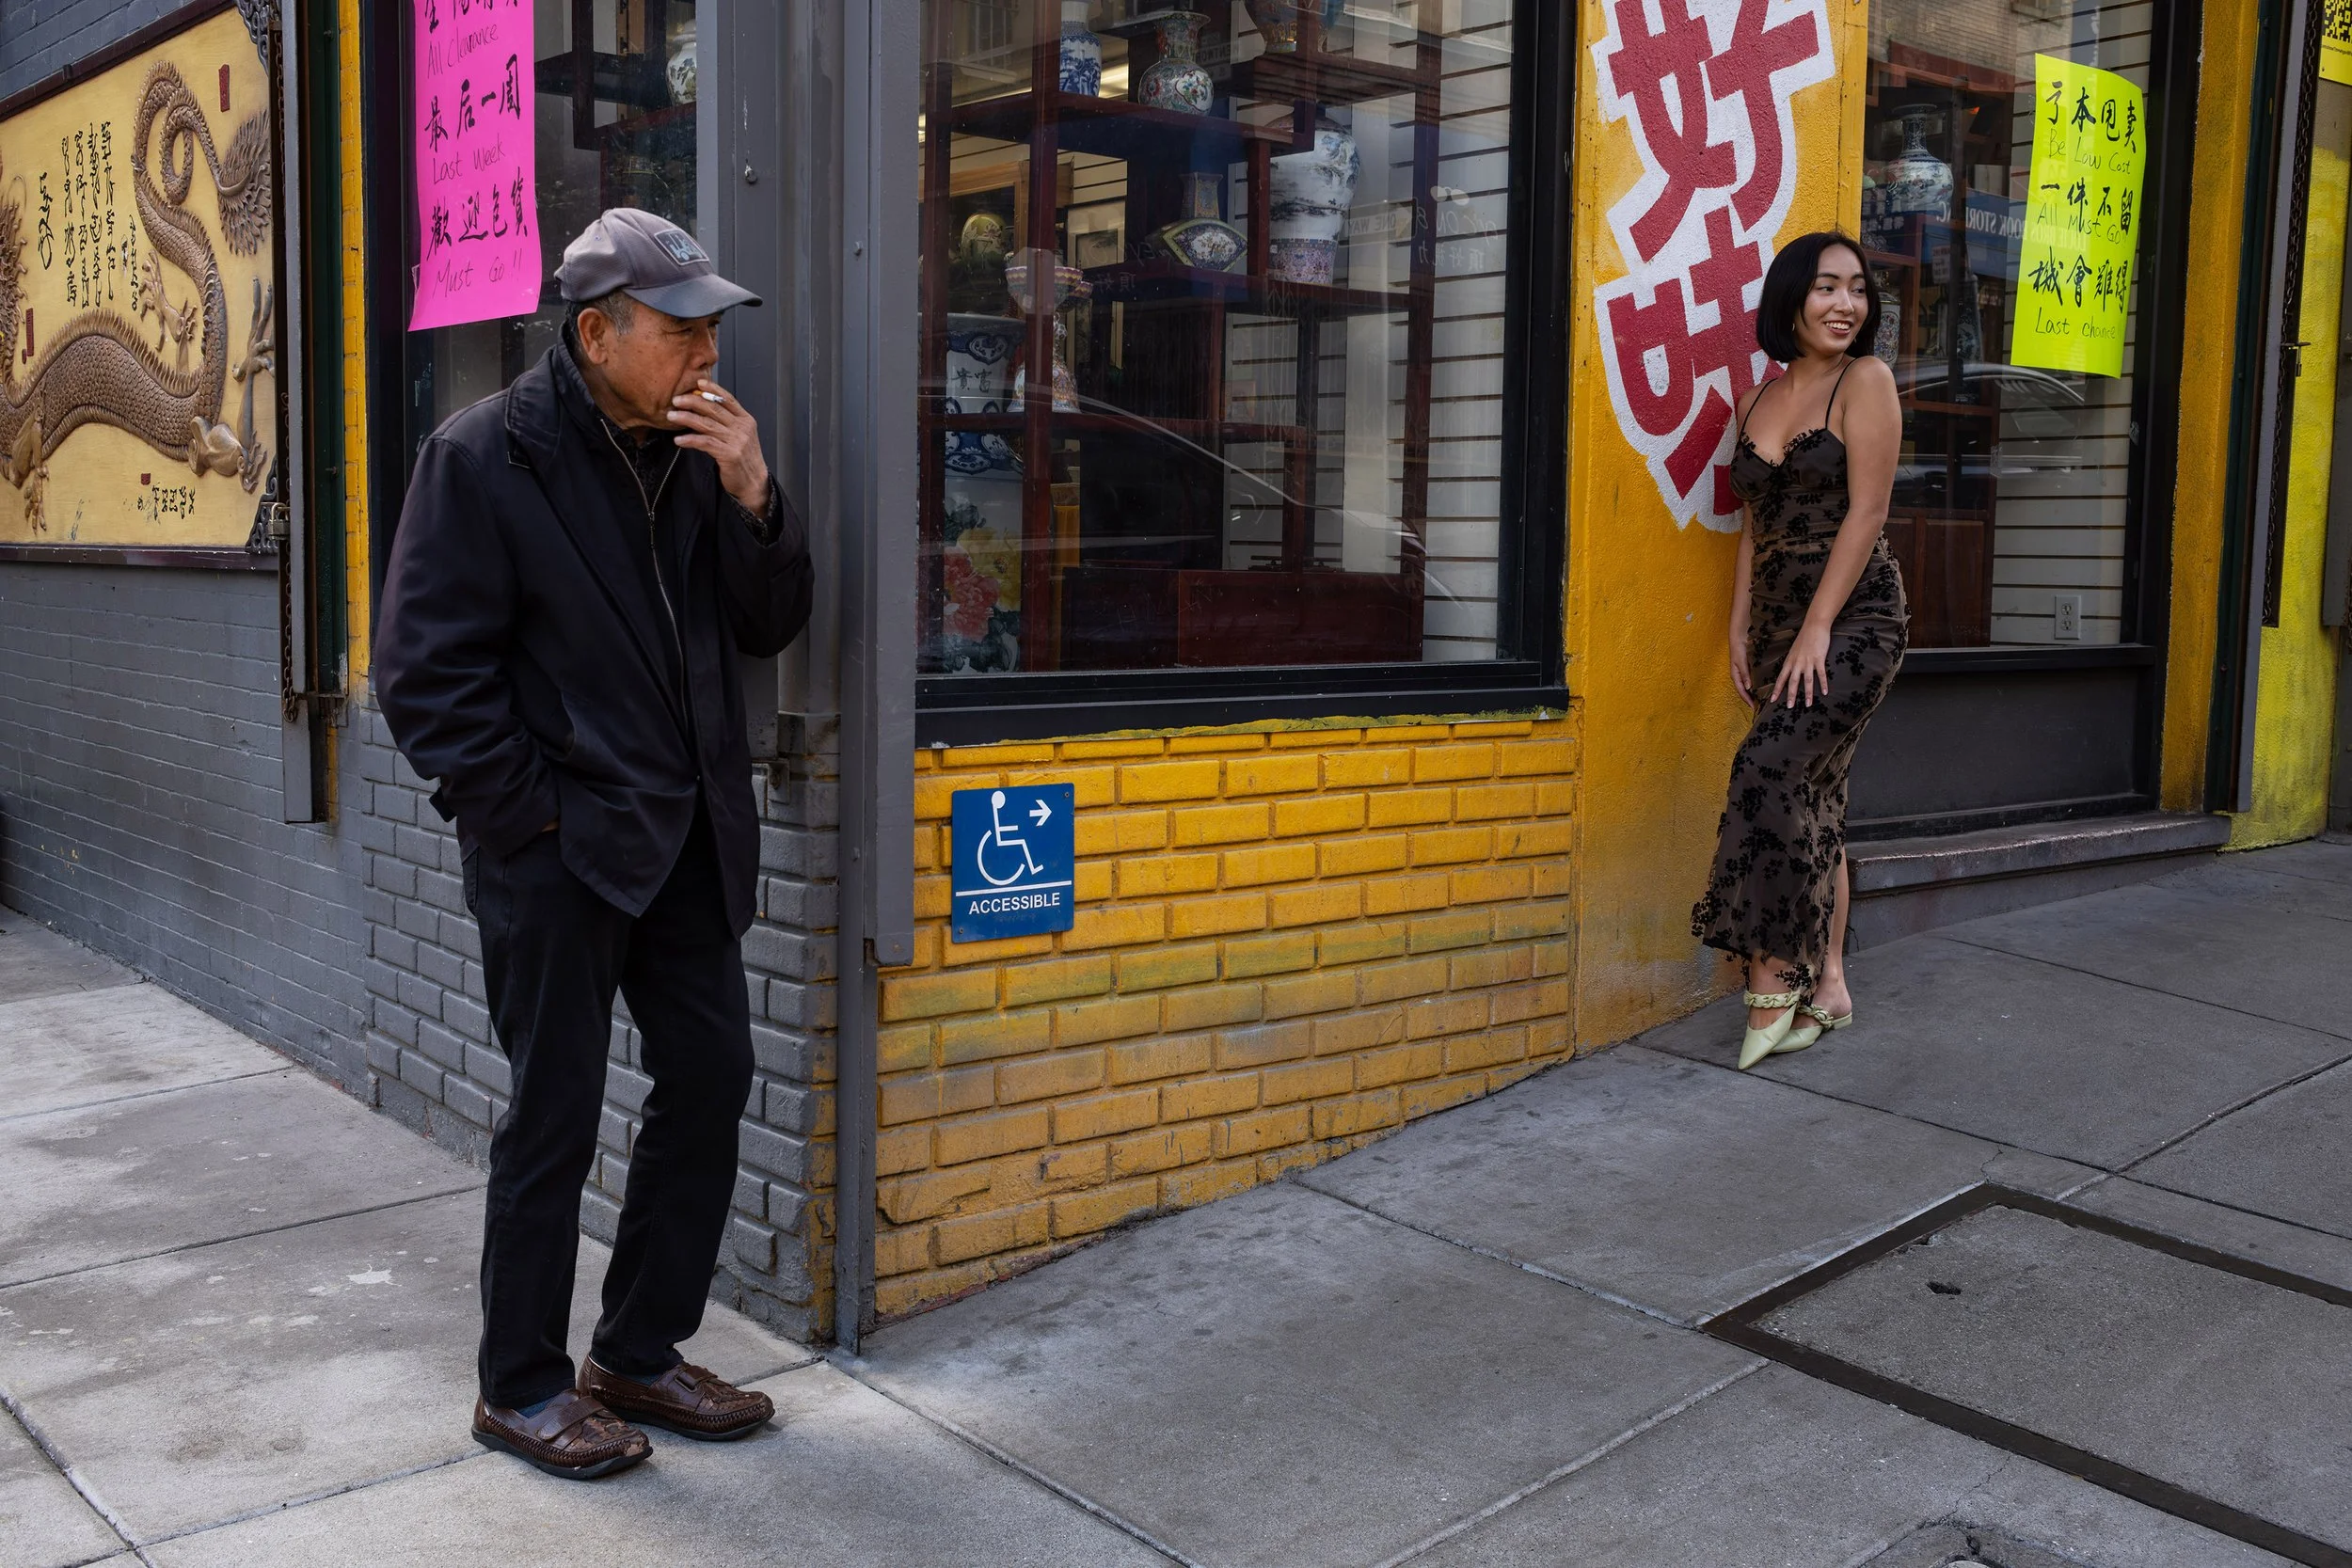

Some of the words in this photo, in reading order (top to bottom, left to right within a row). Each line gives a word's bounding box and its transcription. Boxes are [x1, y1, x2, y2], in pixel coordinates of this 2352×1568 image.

[427, 40, 443, 79] All
[433, 151, 463, 184] Last
[473, 132, 505, 171] Week
[2048, 128, 2066, 158] Be
[2074, 136, 2101, 169] Low
[2108, 151, 2131, 174] Cost
[2037, 202, 2058, 226] All
[432, 259, 473, 298] Must
[2027, 245, 2128, 313] 機會難得
[2035, 307, 2070, 335] Last
[968, 892, 1060, 915] ACCESSIBLE
